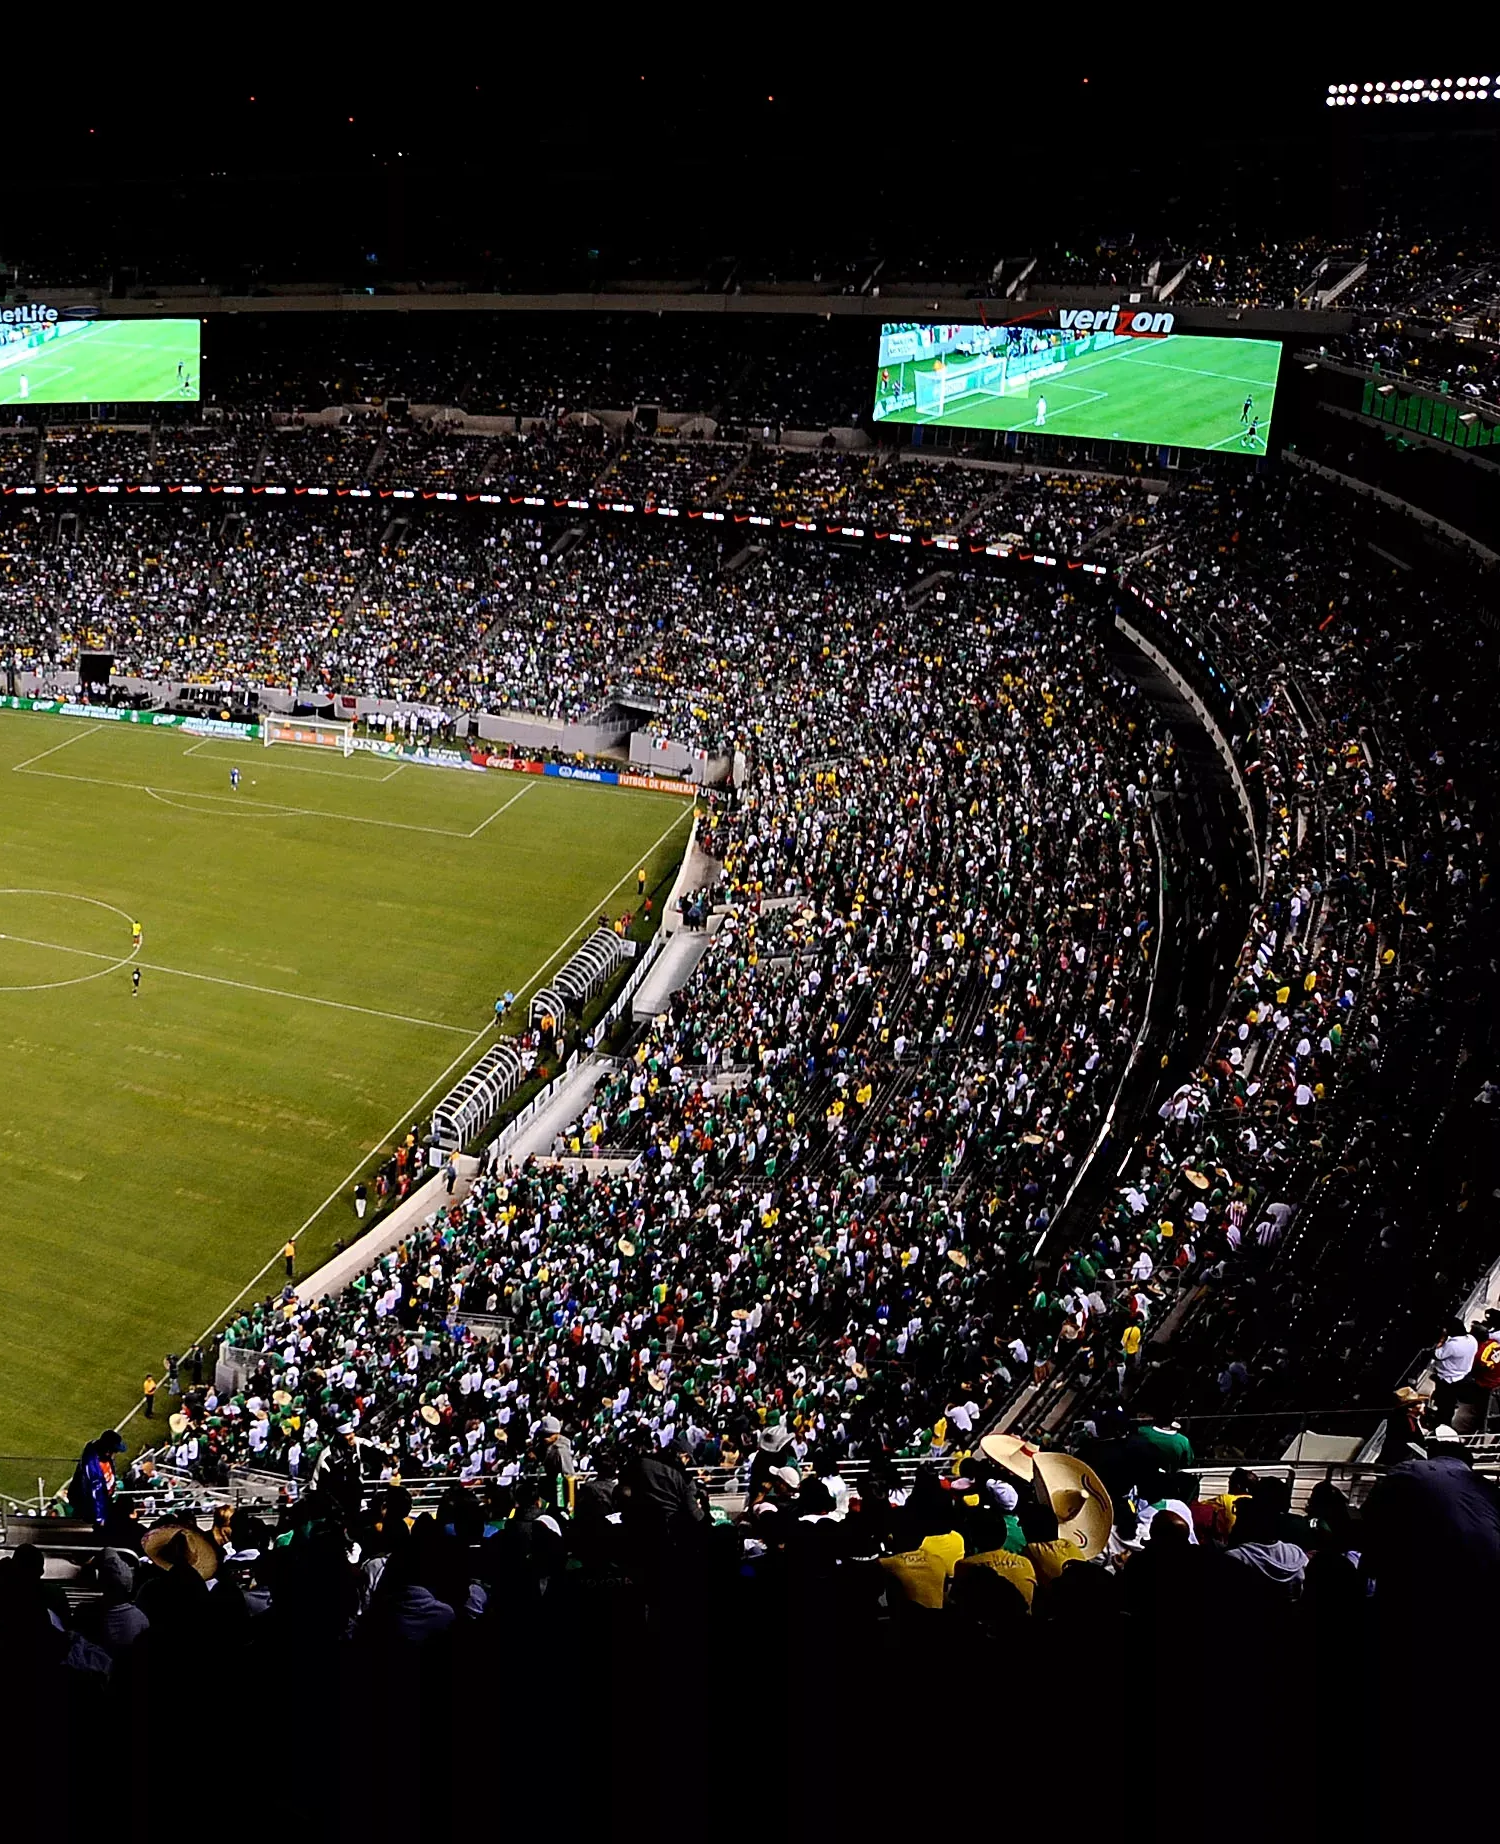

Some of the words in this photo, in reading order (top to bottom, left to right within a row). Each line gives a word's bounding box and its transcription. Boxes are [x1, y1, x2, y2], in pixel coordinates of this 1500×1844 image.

[1059, 304, 1175, 338] verizon
[572, 769, 601, 782] Allstate
[619, 774, 647, 788] FUTBOL
[649, 778, 659, 789] DE
[660, 780, 694, 795] PRIMERA
